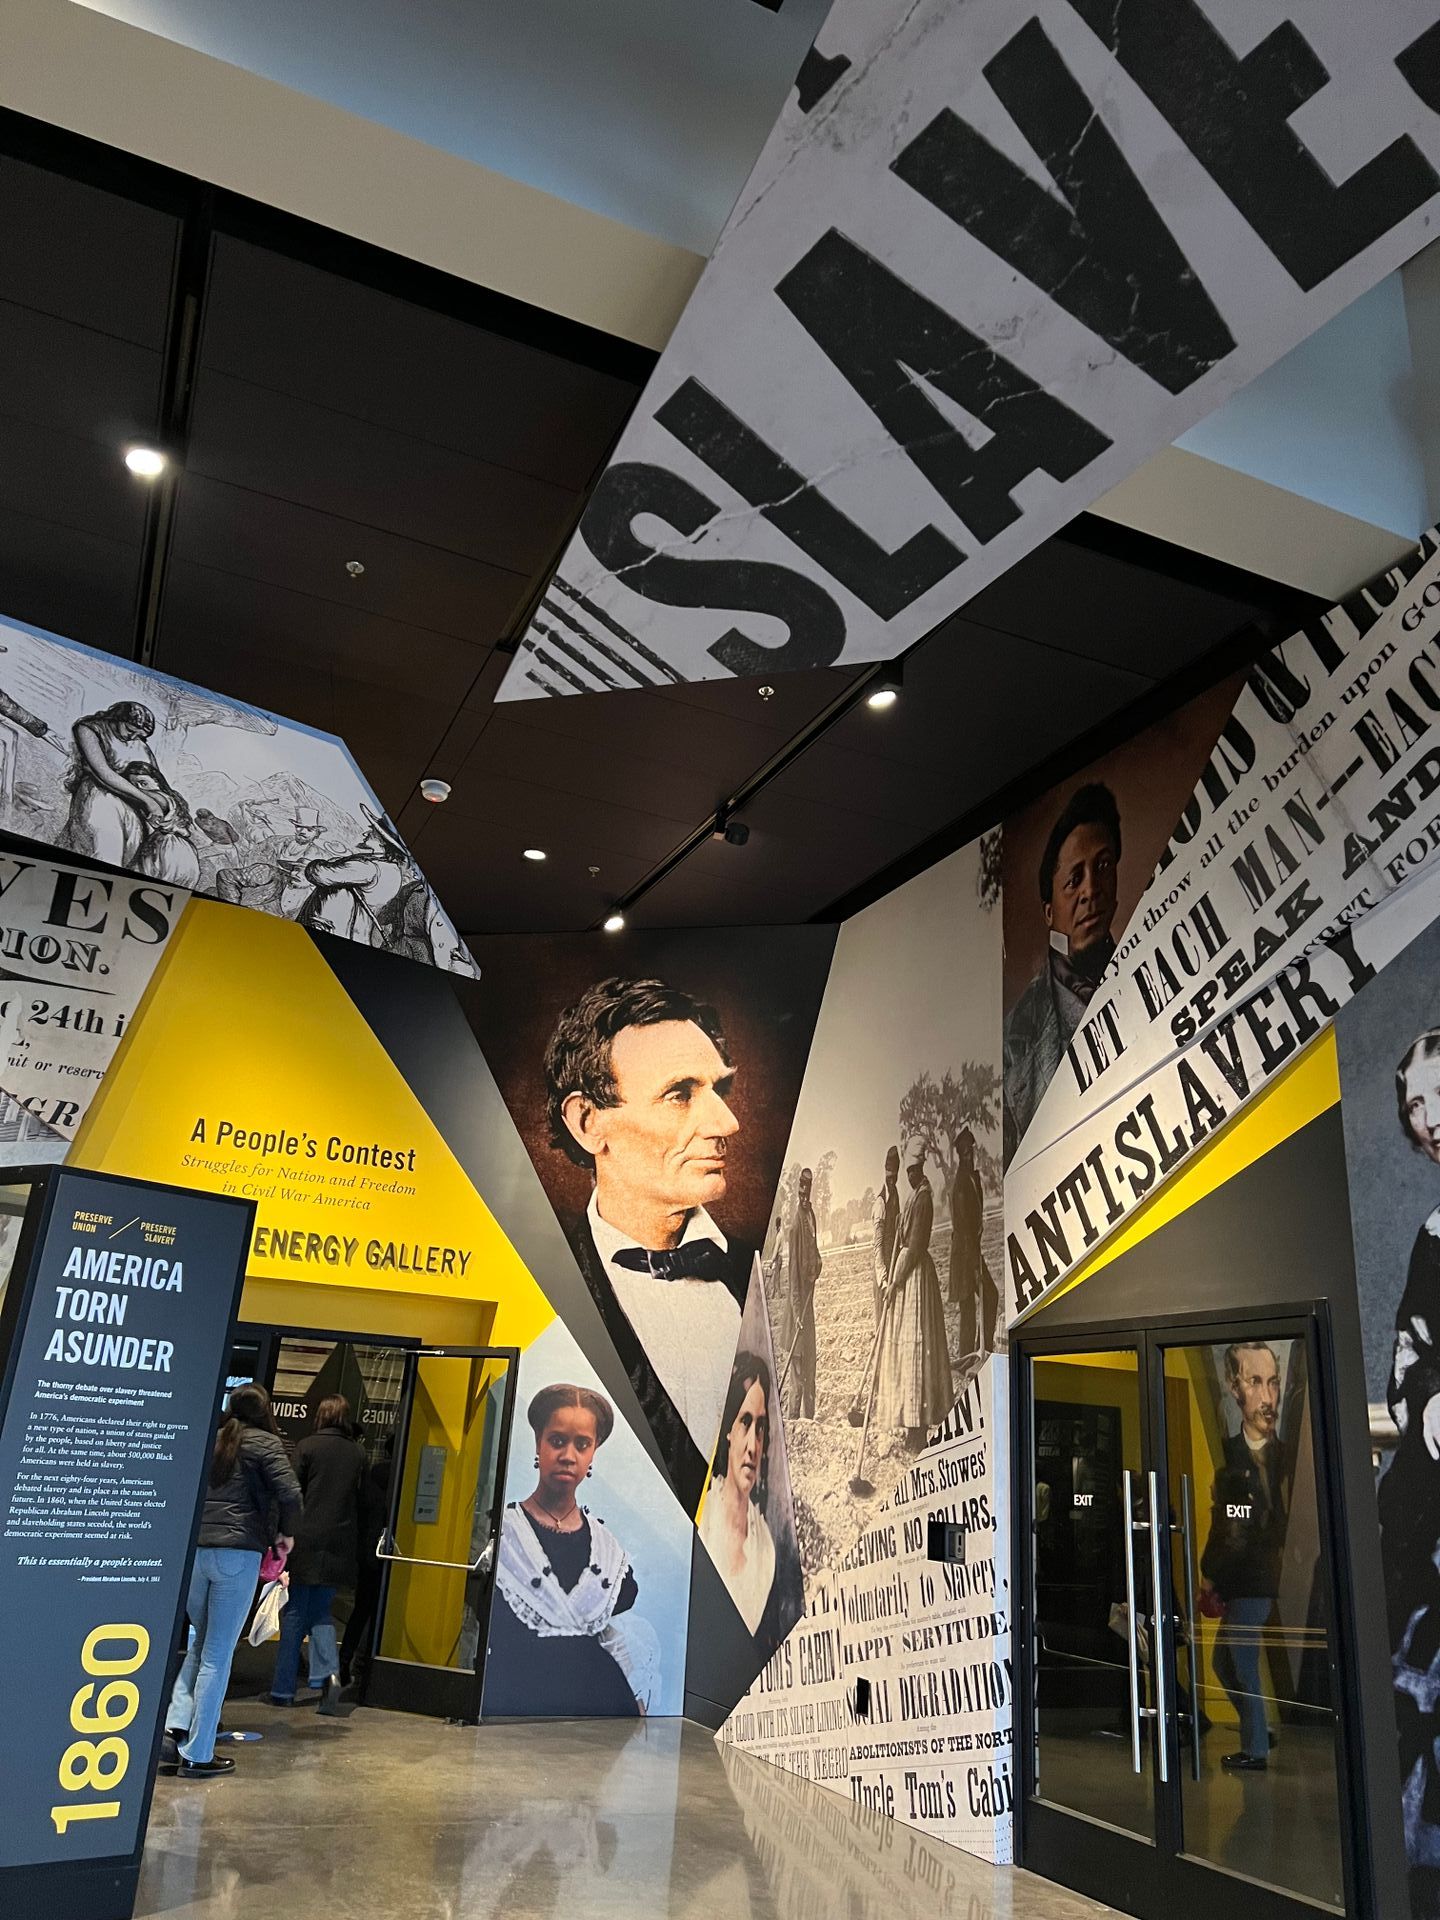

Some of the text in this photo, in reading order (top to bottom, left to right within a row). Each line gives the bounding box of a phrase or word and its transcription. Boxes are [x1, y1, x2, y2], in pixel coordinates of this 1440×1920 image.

[580, 0, 1440, 677] SLAVE
[1109, 572, 1440, 977] you throw all the burden upon GO
[0, 926, 111, 975] ION.
[1170, 879, 1324, 1047] SPEAK
[1069, 998, 1128, 1096] LET
[1132, 891, 1231, 1023] EACH
[28, 1000, 104, 1034] 24th
[35, 1061, 52, 1072] or
[1007, 922, 1378, 1315] ANTI-SLAVERY
[190, 1118, 416, 1172] A People's Contest
[181, 1153, 417, 1197] Struggles for Nation and Freedom
[222, 1180, 371, 1211] in Civil War America
[72, 1222, 97, 1234] UNION
[74, 1211, 113, 1225] PRESERVE
[140, 1222, 177, 1236] PRESERVE
[144, 1233, 175, 1246] SLAVERY
[253, 1226, 472, 1277] ENERGY GALLERY
[62, 1246, 183, 1293] AMERICA
[55, 1286, 128, 1326] TORN
[44, 1329, 174, 1373] ASUNDER
[34, 1390, 144, 1406] America's democratic experiment
[37, 1379, 51, 1388] The
[52, 1381, 74, 1391] thorny
[75, 1383, 98, 1392] debate
[114, 1387, 137, 1397] slavery
[138, 1389, 172, 1398] threatened
[39, 1412, 59, 1422] 1776,
[60, 1414, 96, 1423] Americans
[97, 1417, 125, 1426] declared
[65, 1425, 75, 1433] of
[126, 1429, 135, 1437] of
[153, 1432, 175, 1440] guided
[22, 1444, 34, 1453] for
[47, 1446, 57, 1454] At
[58, 1447, 69, 1455] the
[107, 1450, 127, 1458] about
[127, 1451, 155, 1460] 500,000
[25, 1433, 34, 1443] by
[35, 1434, 47, 1442] the
[74, 1436, 94, 1445] based
[16, 1472, 30, 1480] For
[30, 1473, 43, 1481] the
[119, 1477, 154, 1485] Americans
[19, 1456, 57, 1465] Americans
[76, 1459, 91, 1467] held
[100, 1460, 125, 1470] slavery.
[910, 1467, 939, 1500] Mrs.
[938, 1442, 987, 1491] Stowes'
[13, 1483, 43, 1492] debated
[43, 1484, 68, 1495] slavery
[68, 1486, 83, 1494] and
[120, 1487, 131, 1496] the
[68, 1497, 86, 1505] when
[87, 1497, 99, 1505] the
[100, 1498, 123, 1506] United
[123, 1499, 143, 1507] States
[1073, 1494, 1093, 1506] EXIT
[6, 1517, 21, 1525] and
[21, 1518, 66, 1528] slaveholding
[116, 1520, 127, 1528] the
[9, 1506, 141, 1519] Republican Abraham Lincoln president
[1226, 1503, 1252, 1520] EXIT
[3, 1529, 44, 1537] democratic
[44, 1531, 83, 1540] experiment
[84, 1531, 109, 1539] seemed
[903, 1516, 923, 1554] NO
[17, 1556, 38, 1565] This
[38, 1557, 47, 1565] is
[47, 1557, 93, 1568] essentially
[99, 1557, 133, 1568] people's
[840, 1572, 910, 1626] Voluntarily
[920, 1571, 934, 1608] to
[844, 1634, 894, 1665] HAPPY
[902, 1611, 1012, 1654] SERVITUDE.
[799, 1628, 843, 1687] CABIN!
[846, 1680, 893, 1728] SOIAL
[50, 1623, 150, 1834] 1860
[757, 1710, 775, 1740] WITH
[776, 1708, 789, 1737] ITS
[790, 1703, 815, 1736] SILVER
[850, 1739, 928, 1761] ABOLITIONISTS
[930, 1738, 946, 1754] OF
[947, 1734, 973, 1752] THE
[812, 1747, 848, 1781] NEGRO
[851, 1762, 1014, 1820] Uncle Tom's Cabi
